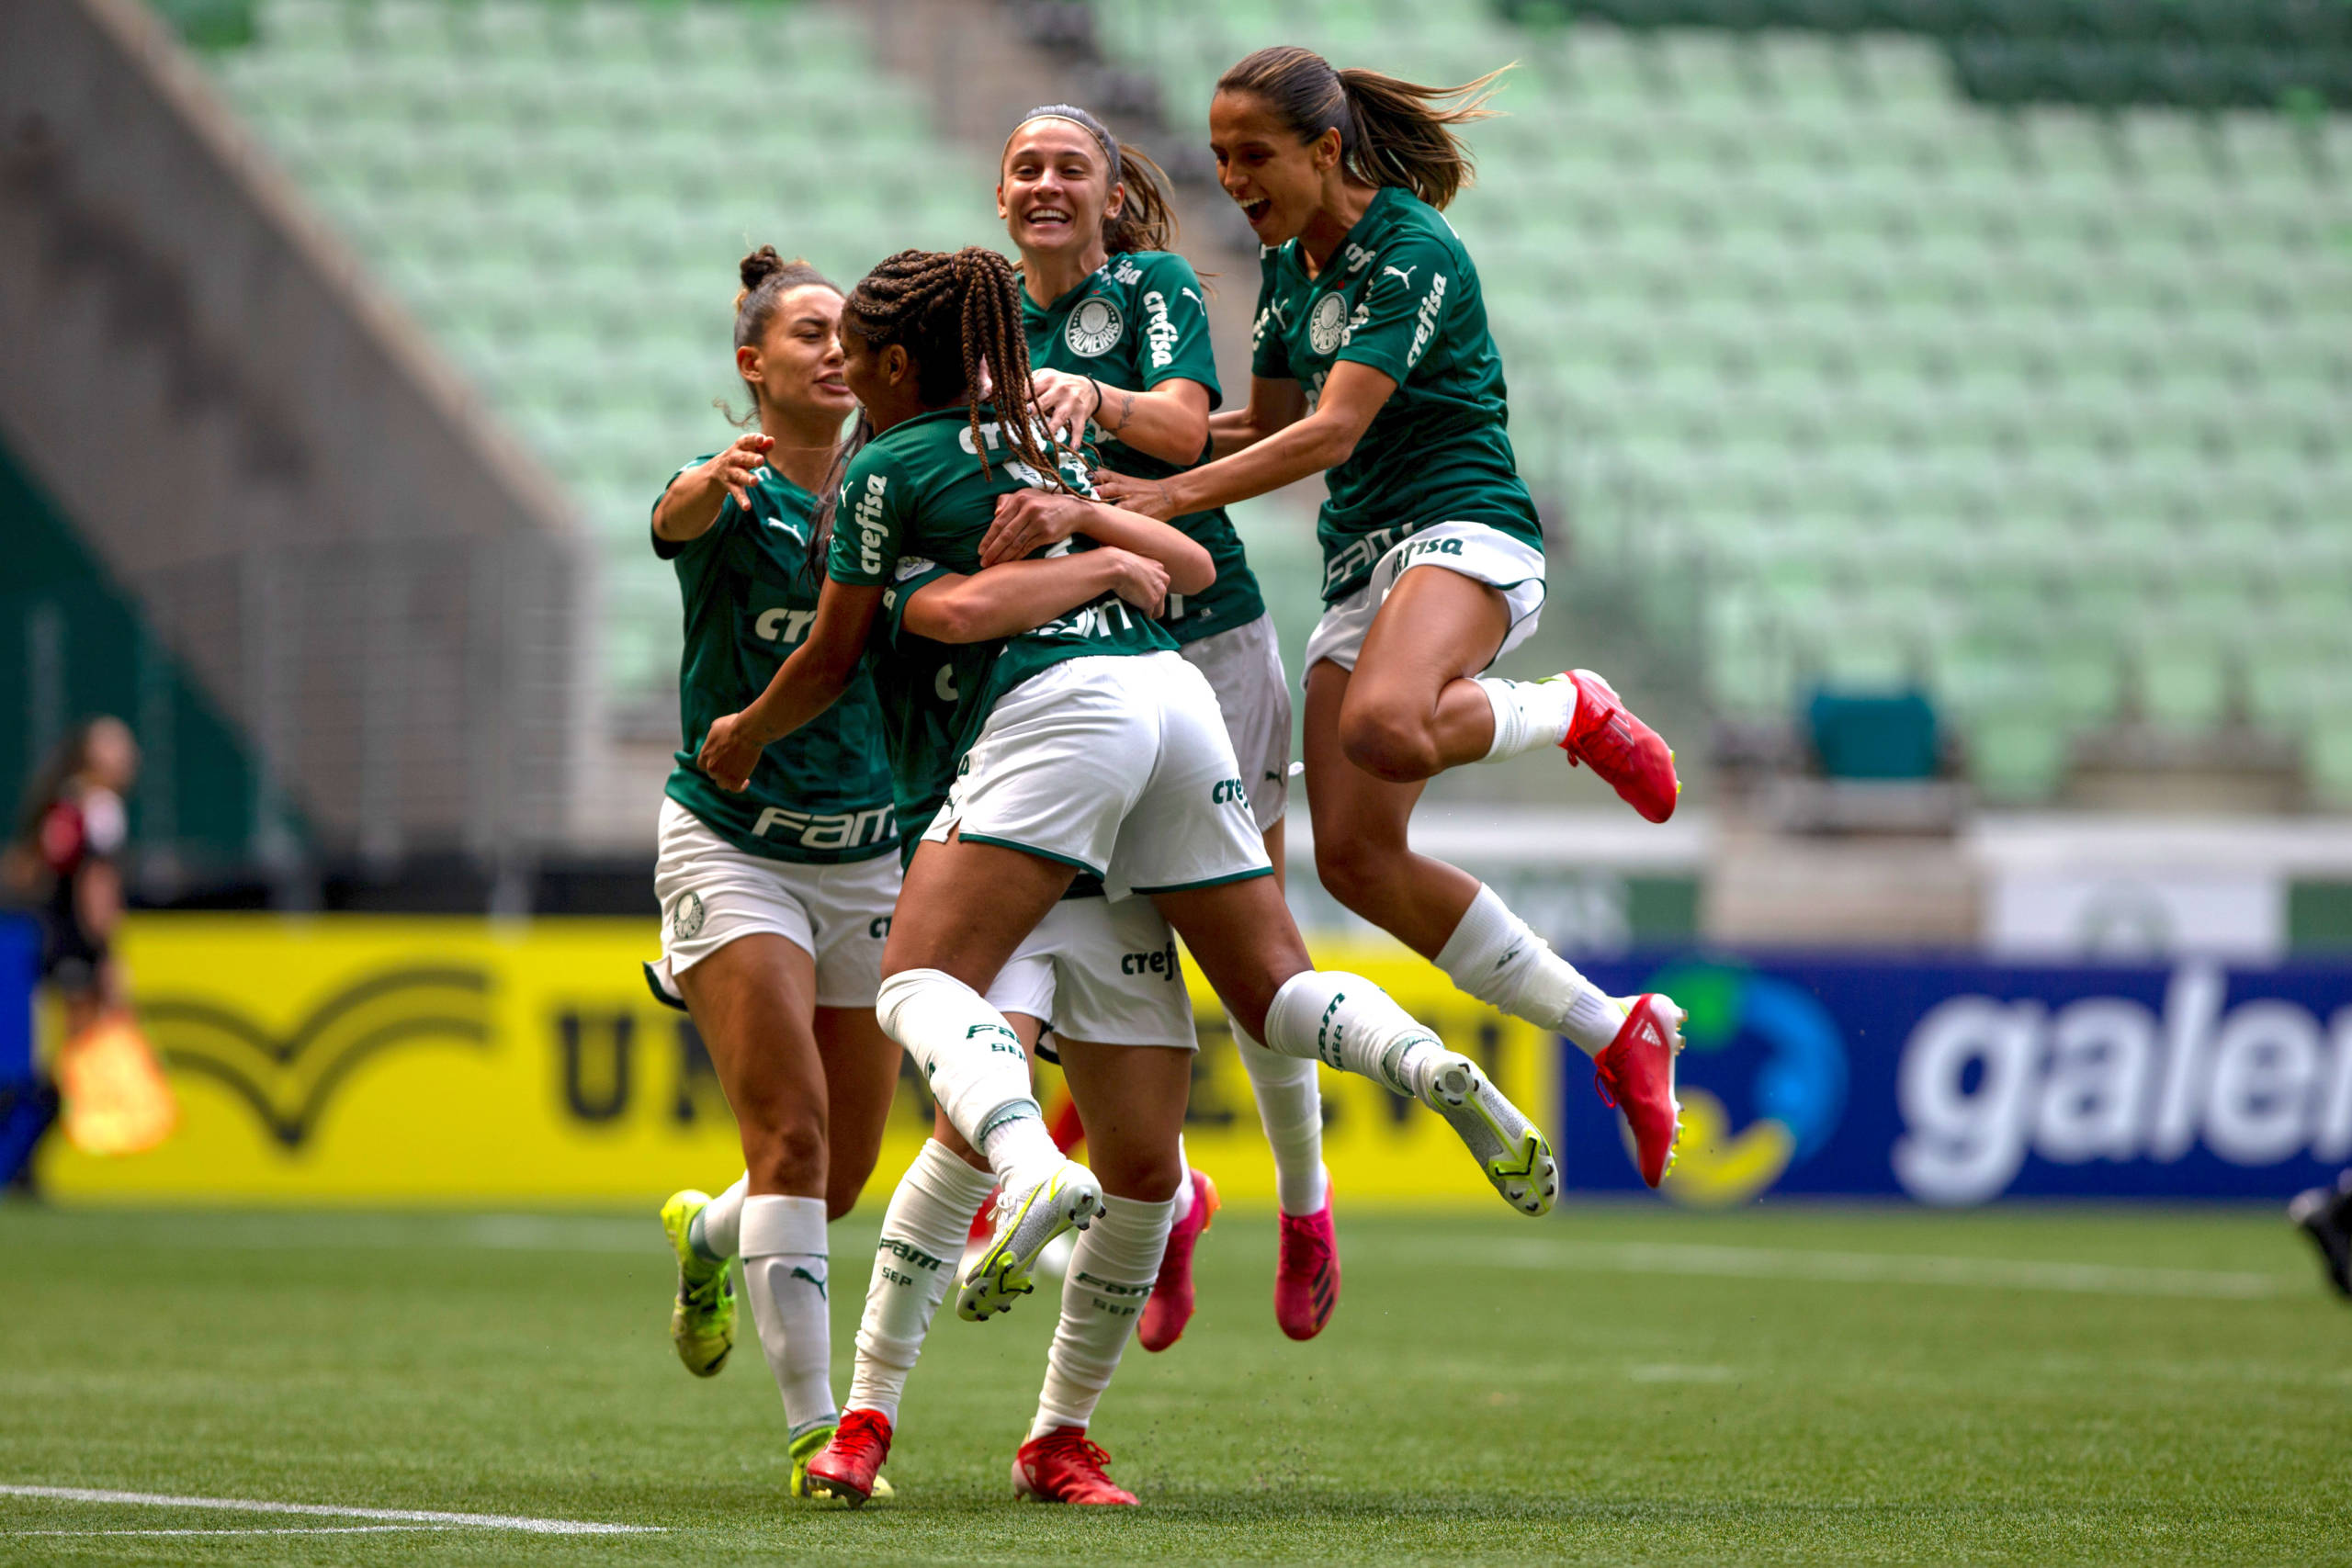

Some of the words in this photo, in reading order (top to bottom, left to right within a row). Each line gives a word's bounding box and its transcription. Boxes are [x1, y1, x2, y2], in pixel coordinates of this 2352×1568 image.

[1069, 322, 1120, 354] PALMEIRAS
[1143, 290, 1179, 368] crefisa
[1408, 272, 1447, 367] crefisa
[855, 473, 889, 576] crefisa
[882, 1267, 912, 1286] SEP
[1093, 1297, 1136, 1315] SEP
